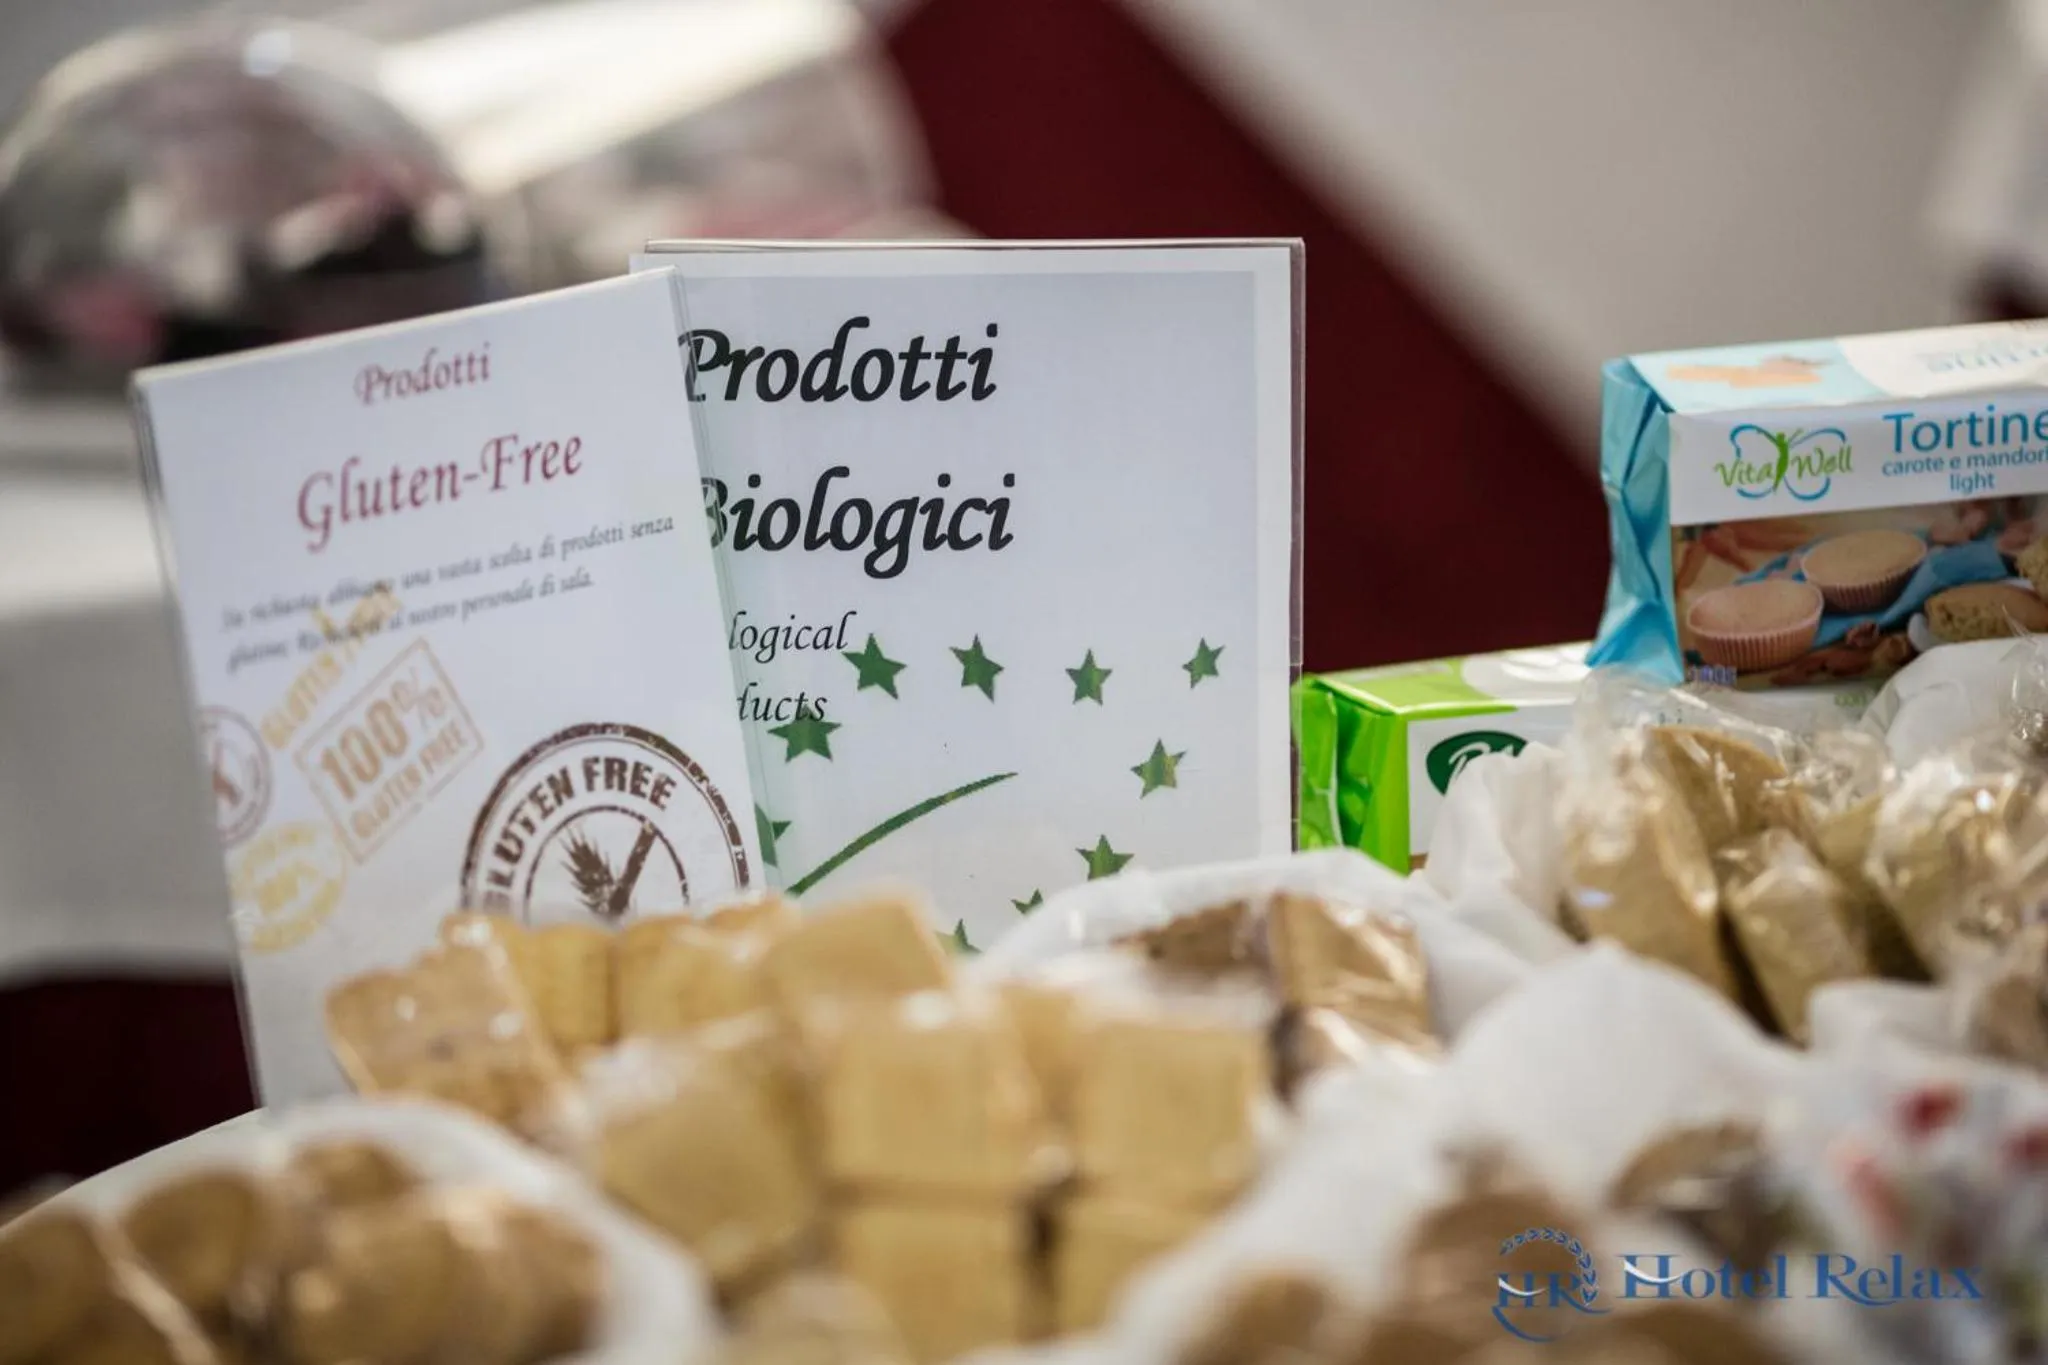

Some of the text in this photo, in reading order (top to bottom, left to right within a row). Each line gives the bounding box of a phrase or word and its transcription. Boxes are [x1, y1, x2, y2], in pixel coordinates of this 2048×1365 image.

[354, 342, 491, 404] Prodotti
[678, 316, 998, 401] Prodotti
[1713, 445, 1853, 487] Vita Well
[1882, 456, 1944, 477] carote
[1950, 456, 1961, 469] e
[1950, 472, 1995, 494] light
[297, 434, 583, 554] Gluten-Free
[539, 534, 554, 558] di
[561, 523, 623, 560] prodotti
[631, 516, 674, 539] senza
[461, 577, 533, 624] personale
[539, 573, 554, 597] di
[321, 666, 447, 802] 100%
[582, 757, 676, 811] FREE
